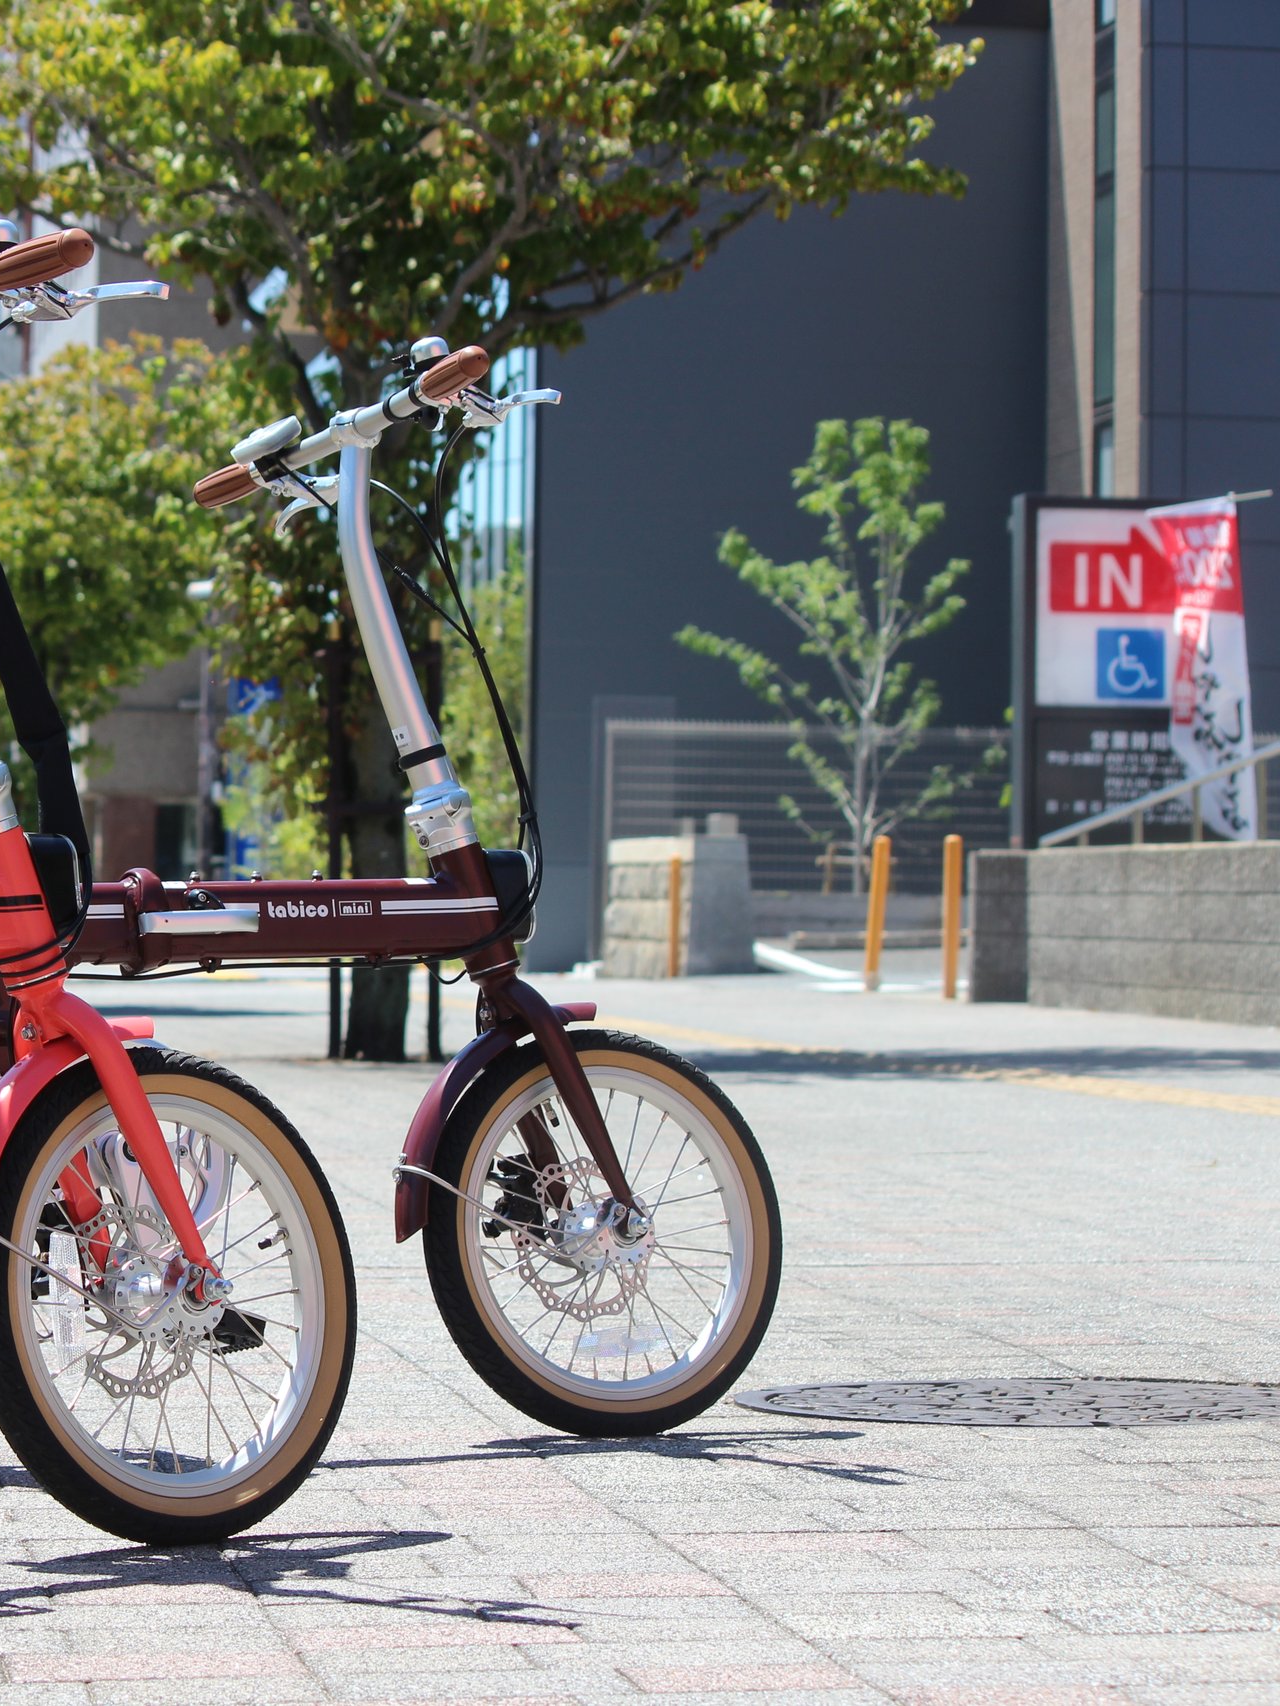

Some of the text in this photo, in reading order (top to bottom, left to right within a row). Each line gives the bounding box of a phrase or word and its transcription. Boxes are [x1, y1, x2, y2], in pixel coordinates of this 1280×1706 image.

[1074, 553, 1143, 608] IN
[267, 900, 369, 918] tabico mini
